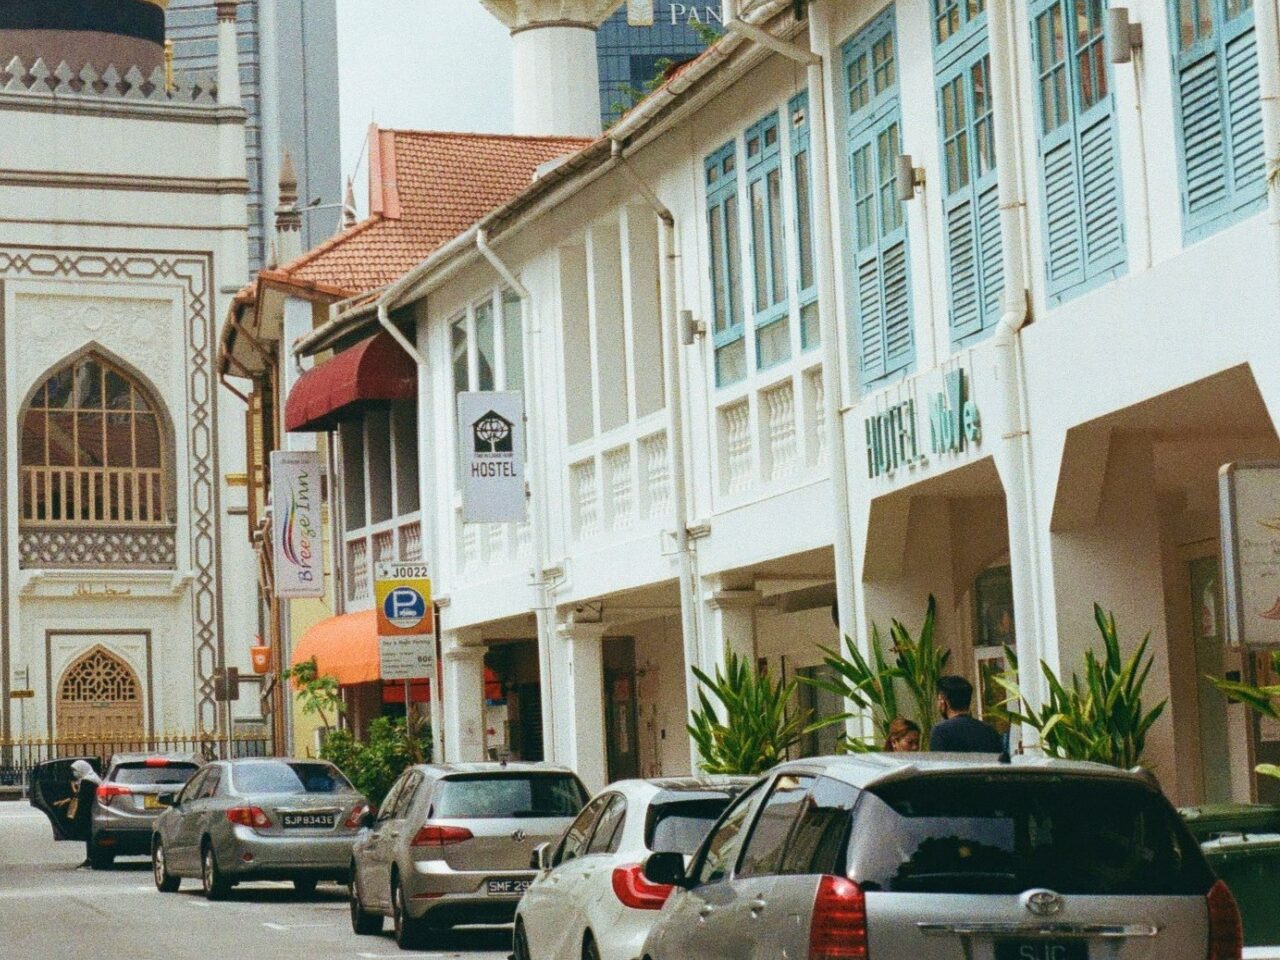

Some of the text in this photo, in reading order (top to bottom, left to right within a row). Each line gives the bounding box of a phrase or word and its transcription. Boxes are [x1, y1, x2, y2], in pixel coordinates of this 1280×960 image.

[864, 398, 926, 479] HOTEL
[471, 462, 517, 478] HOSTEL
[295, 469, 316, 583] Breeze Inn
[393, 566, 428, 578] J0022
[392, 590, 418, 618] P
[513, 880, 534, 891] 29
